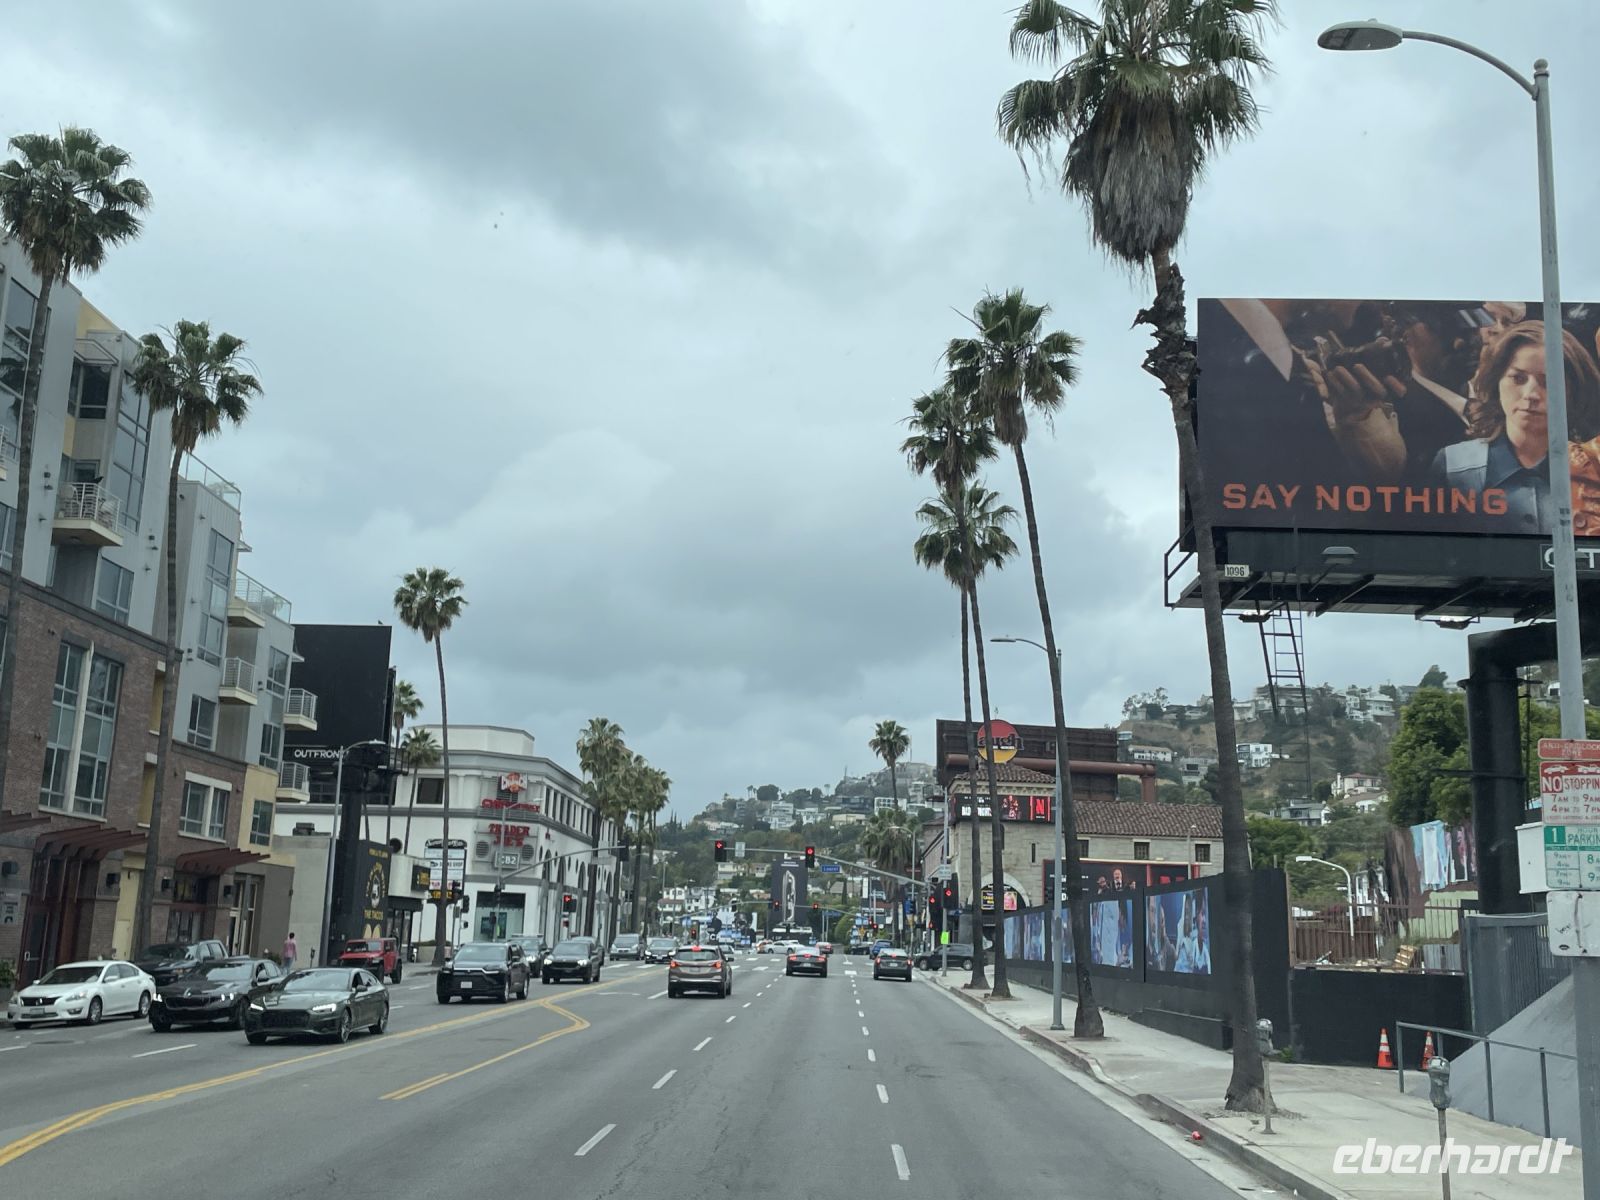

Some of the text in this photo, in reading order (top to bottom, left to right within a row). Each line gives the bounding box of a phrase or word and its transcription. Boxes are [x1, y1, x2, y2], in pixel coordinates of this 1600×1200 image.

[1223, 483, 1509, 515] SAY NOTHING
[1226, 566, 1245, 577] 1096
[1541, 775, 1563, 792] NO
[1551, 827, 1558, 844] 1
